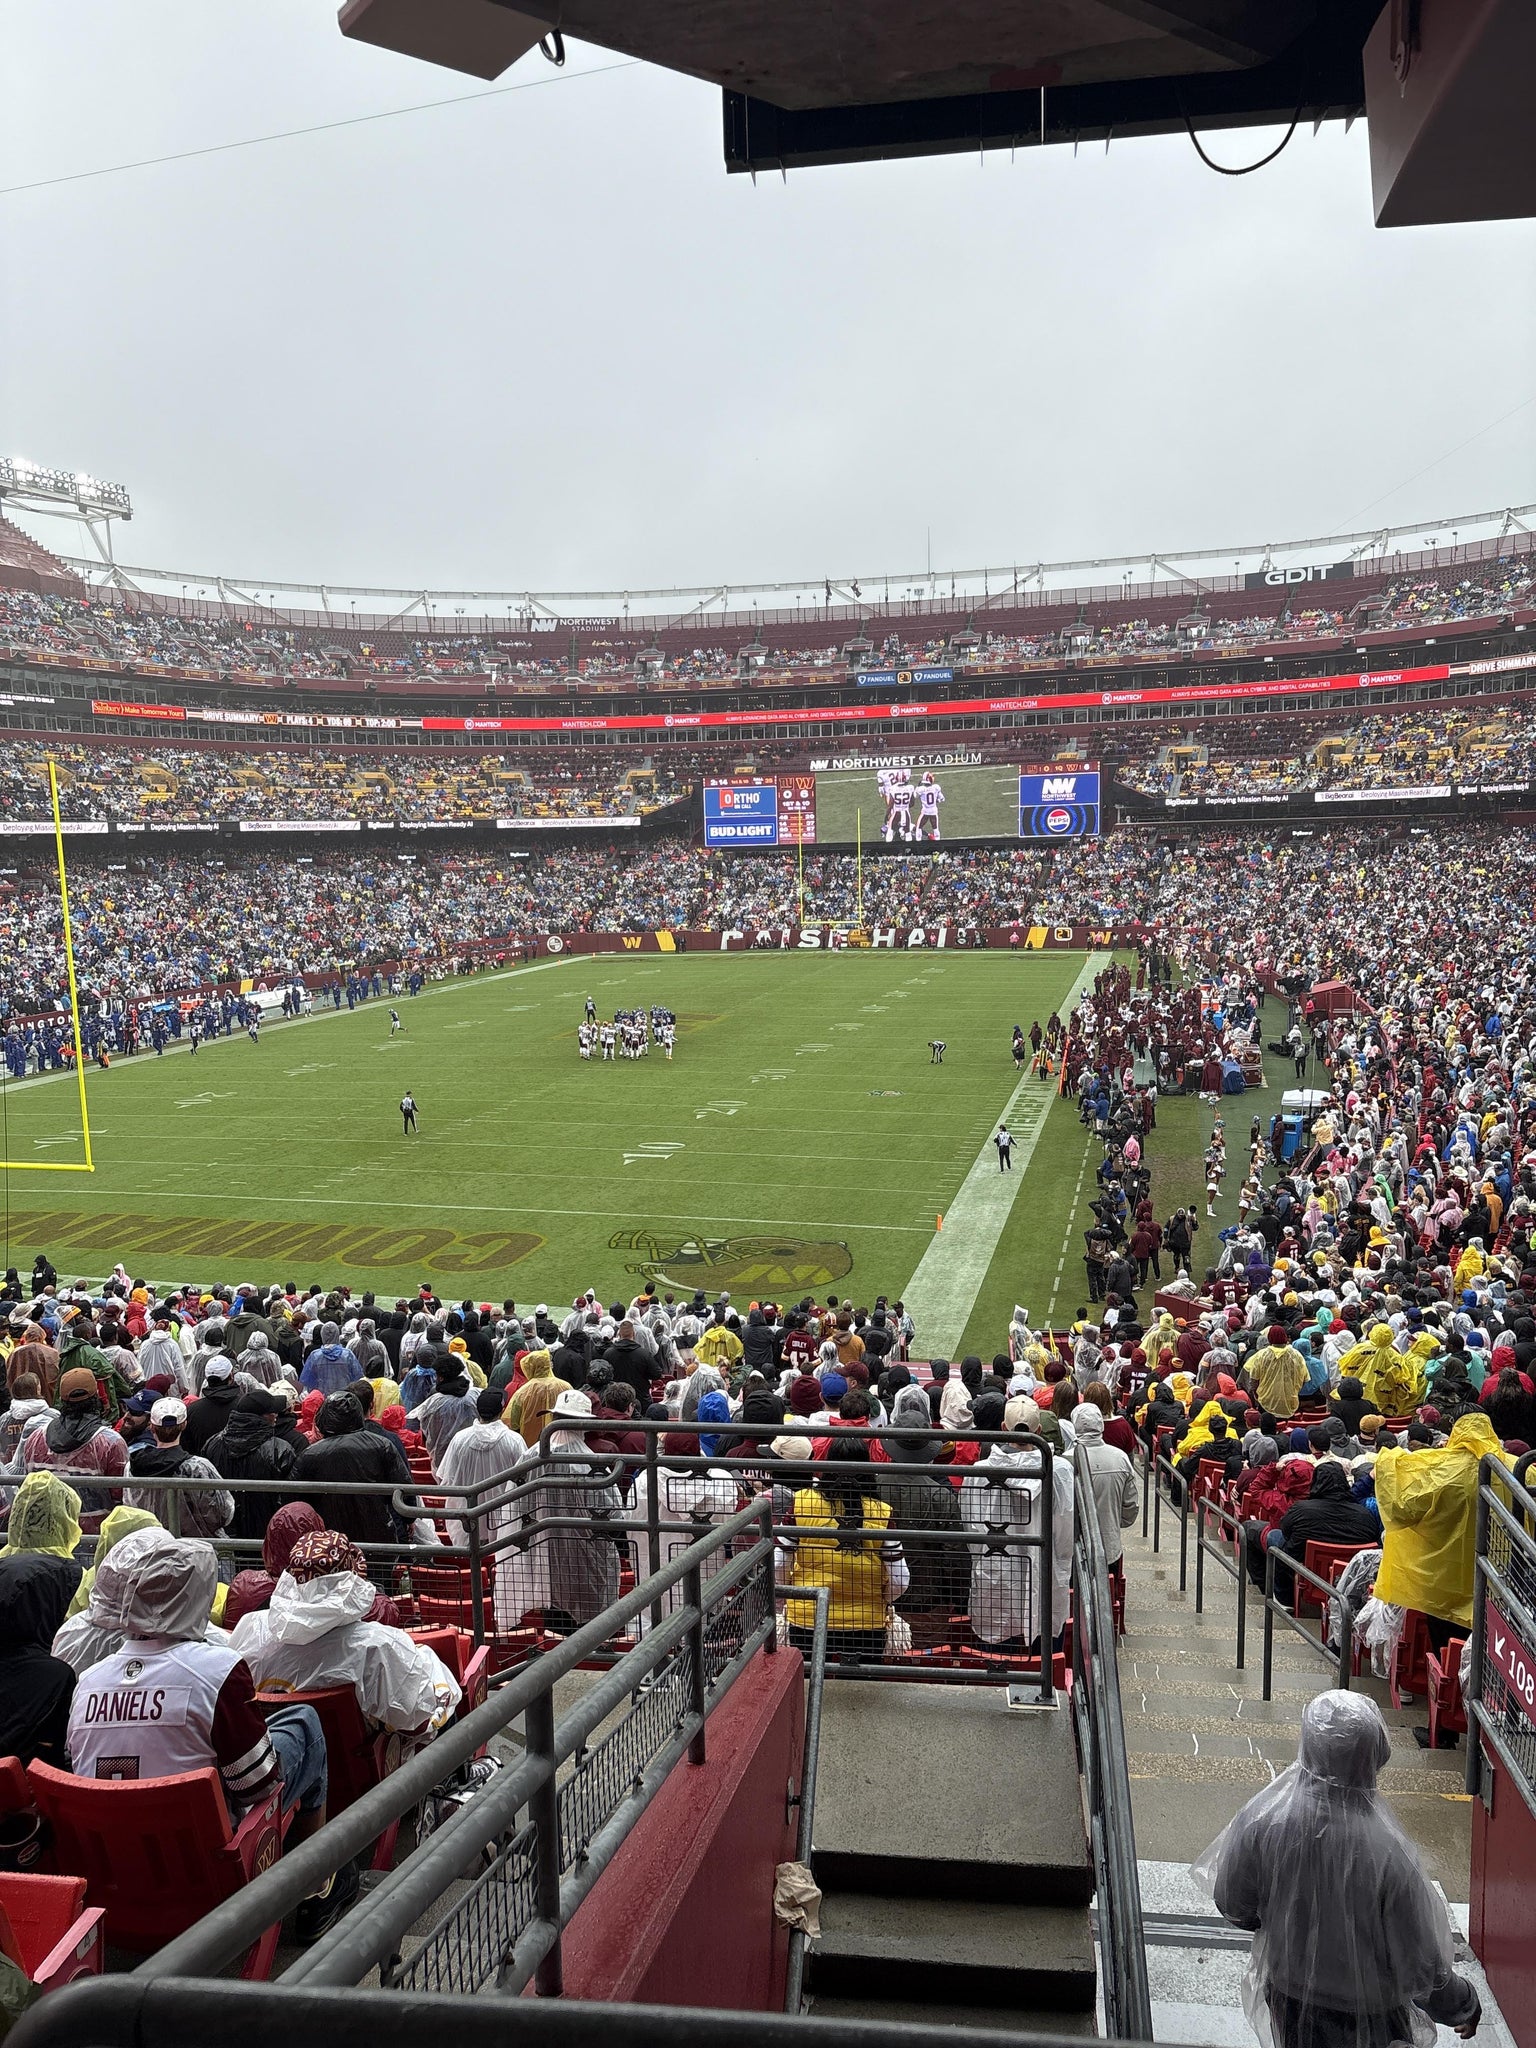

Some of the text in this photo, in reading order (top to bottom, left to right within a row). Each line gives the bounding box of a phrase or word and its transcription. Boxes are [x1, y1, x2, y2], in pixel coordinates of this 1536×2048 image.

[1265, 564, 1334, 585] GDIT
[531, 619, 558, 632] NW
[1470, 656, 1536, 674] DRIVE SUMMARY
[1371, 675, 1402, 684] MANTECH
[1113, 694, 1143, 702] MANTECH
[901, 706, 928, 714] MANTECH
[990, 700, 1038, 710] MANTECH.COM
[140, 707, 168, 715] Tomorrow
[168, 709, 184, 717] Yours
[203, 711, 223, 720] DRIVE
[224, 713, 260, 722] SUMMARY
[475, 721, 502, 729] MANTECH
[562, 720, 607, 728] MANTECH.COM
[675, 717, 702, 725] MANTECH
[811, 752, 981, 769] NW NORTHWEST STADIUM
[1042, 778, 1076, 794] NW
[725, 793, 760, 804] ORTHO
[783, 790, 809, 799] 0 6
[895, 793, 909, 805] 52
[927, 792, 934, 805] 0
[1361, 790, 1388, 799] Deploying
[1388, 789, 1409, 798] Mission
[1409, 789, 1425, 797] Ready
[1205, 796, 1237, 805] Deploying
[1237, 795, 1261, 803] Mission
[1262, 795, 1282, 803] Ready
[3, 824, 34, 833] Deploying
[151, 823, 176, 832] Deploying
[177, 823, 196, 831] Mission
[197, 823, 212, 832] Ready
[400, 821, 427, 830] Deploying
[449, 821, 466, 829] Ready
[466, 820, 474, 828] AI
[710, 826, 773, 837] BUD LIGHT
[622, 936, 642, 949] W
[1508, 1650, 1535, 1706] 108
[85, 1689, 165, 1723] DANIELS
